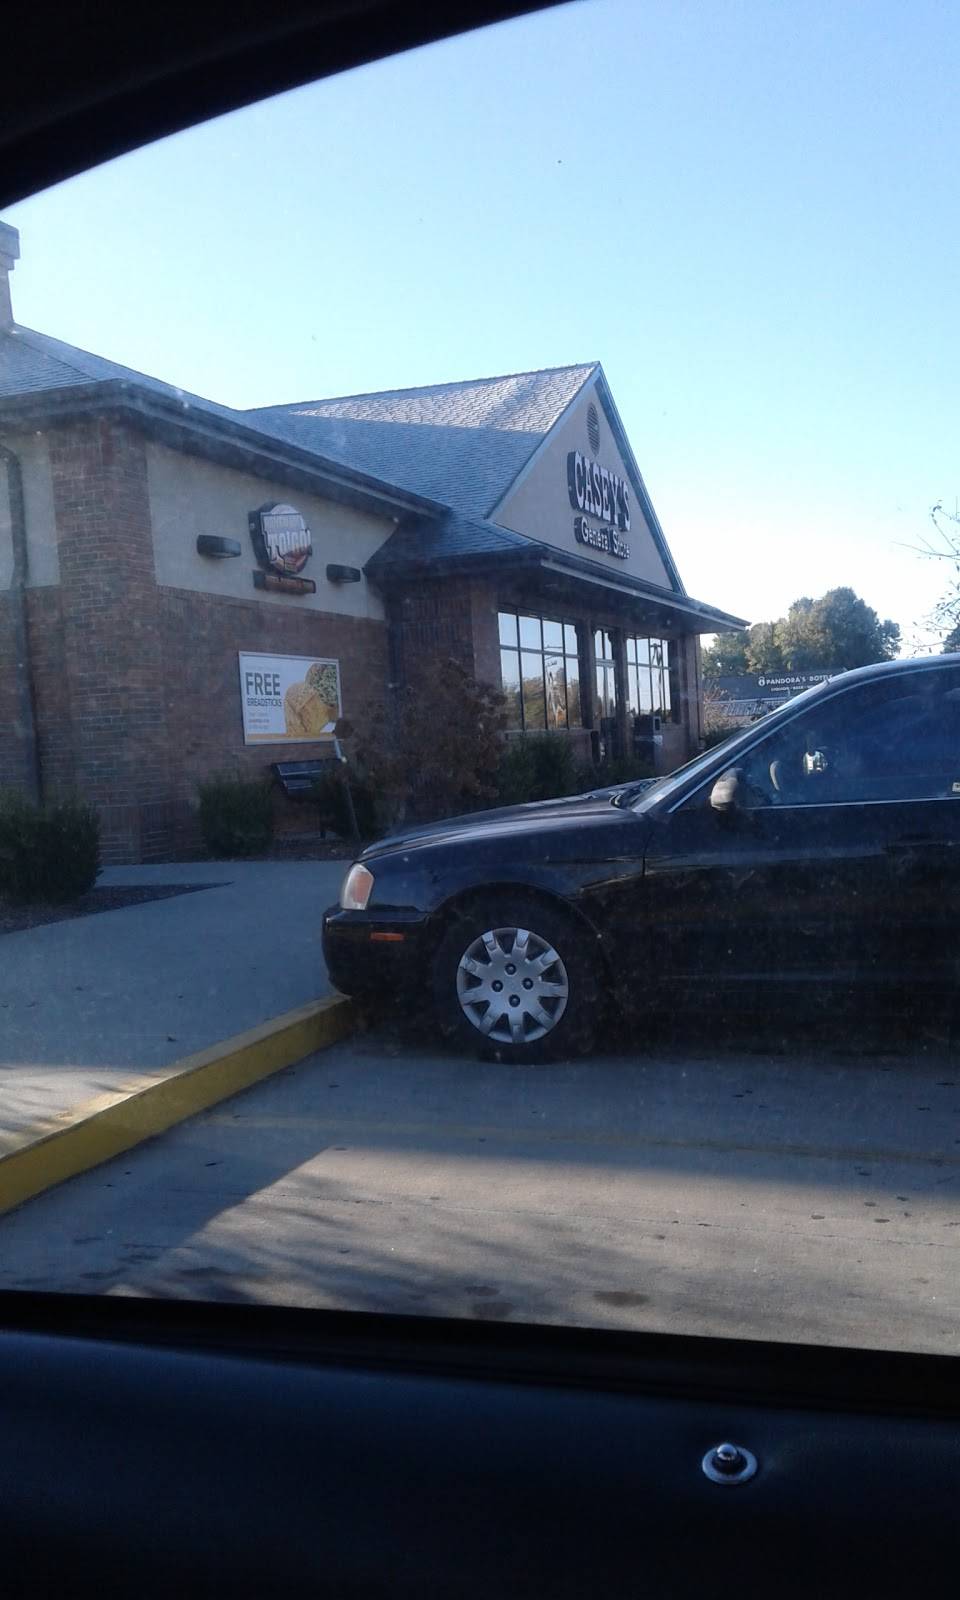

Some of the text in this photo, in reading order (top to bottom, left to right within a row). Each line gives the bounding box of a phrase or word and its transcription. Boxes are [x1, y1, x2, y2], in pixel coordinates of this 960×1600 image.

[572, 450, 631, 532] CASEY'S
[578, 516, 611, 552] General
[245, 672, 281, 696] FREE
[766, 676, 806, 685] PANDORA'S
[247, 697, 283, 707] BREADSTICKS
